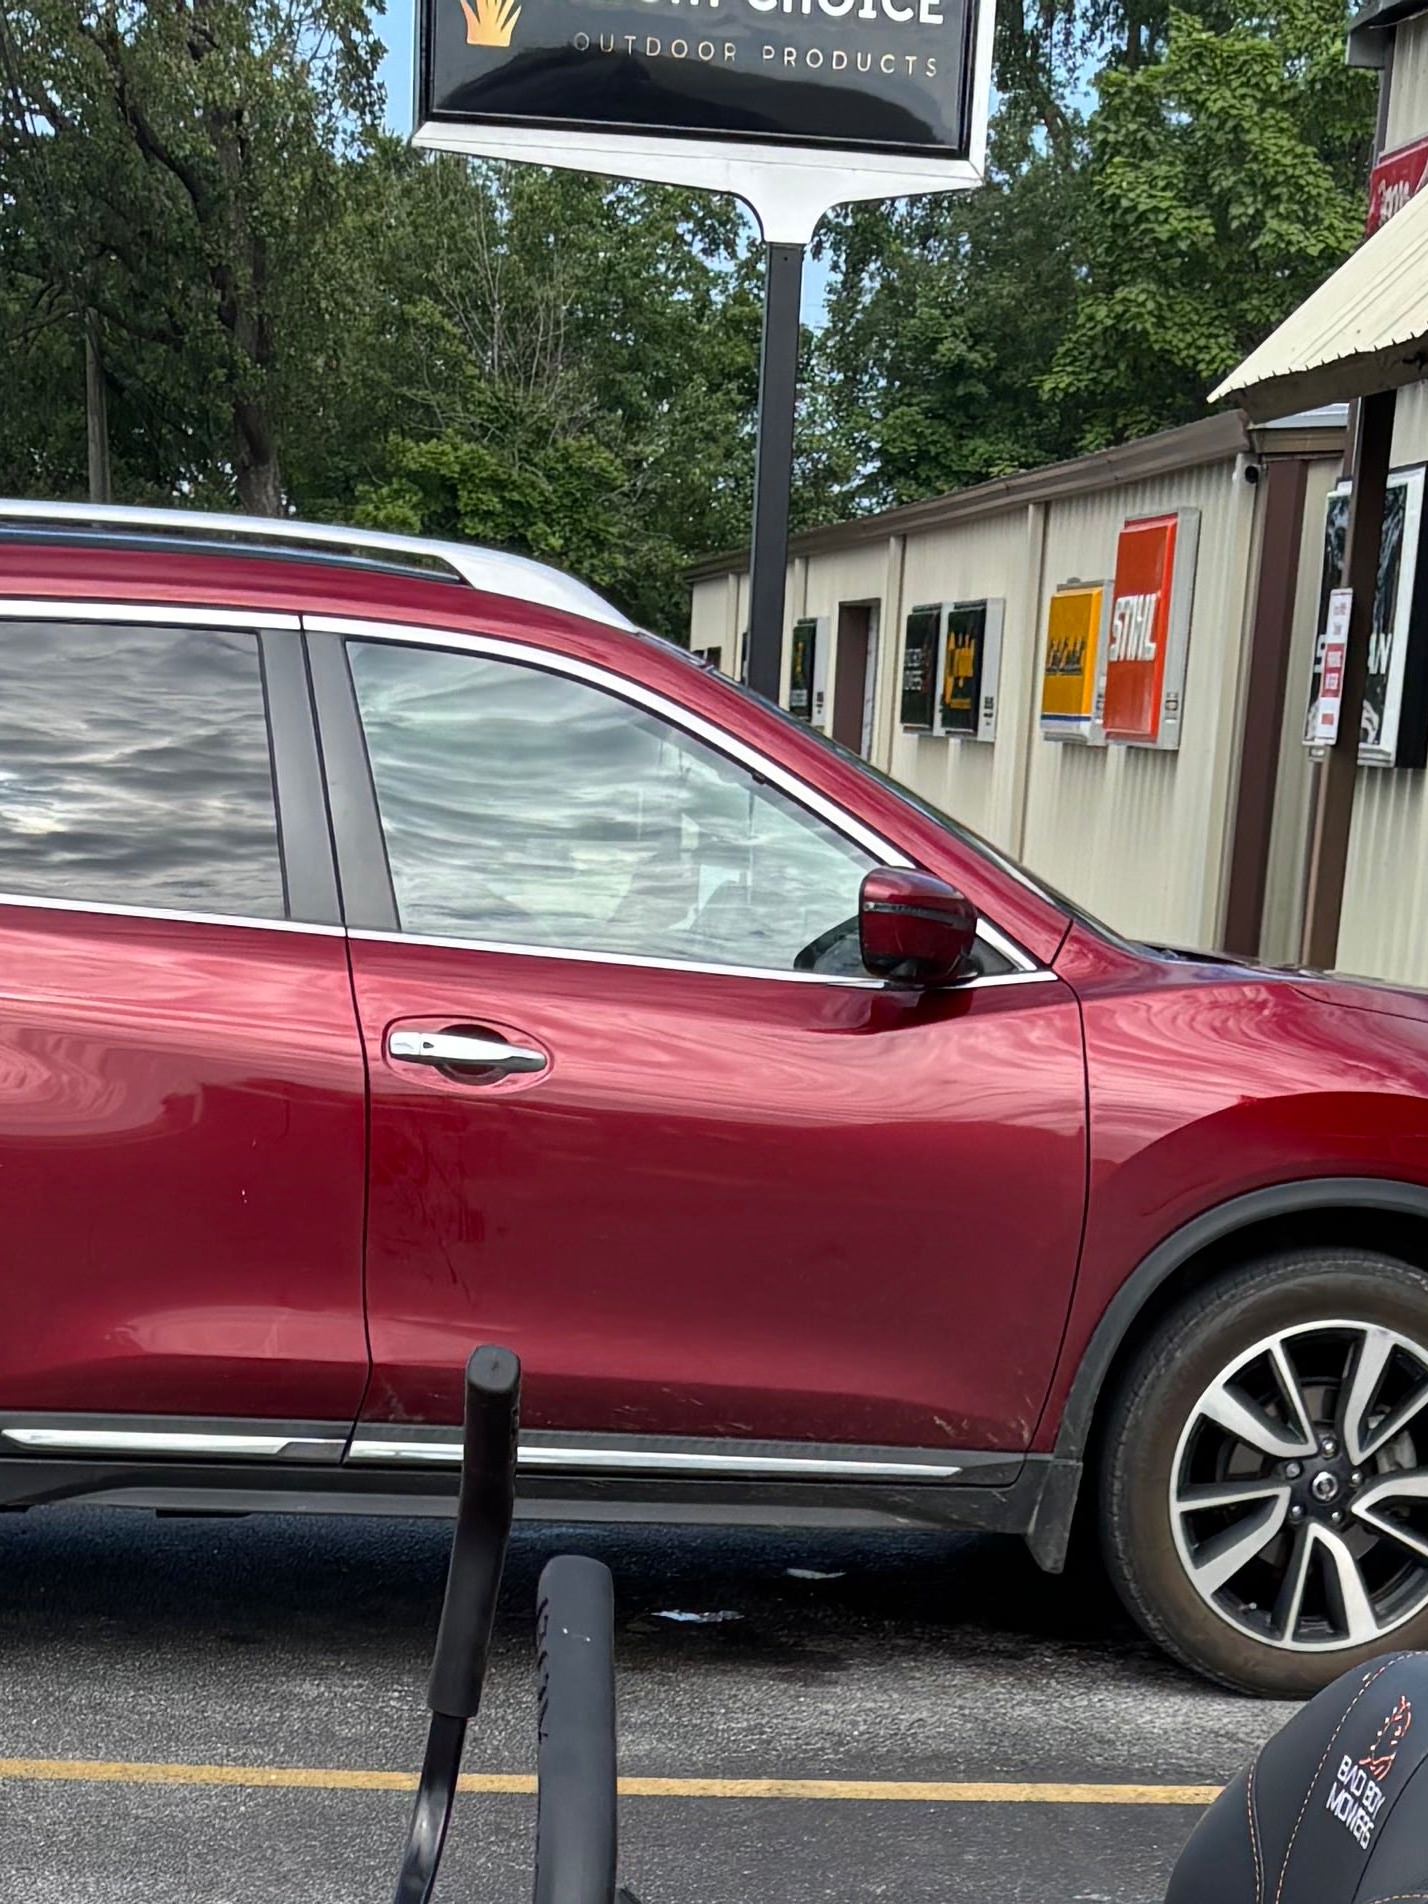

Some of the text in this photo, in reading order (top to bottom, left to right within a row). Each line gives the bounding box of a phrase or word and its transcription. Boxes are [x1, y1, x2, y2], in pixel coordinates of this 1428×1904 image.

[573, 32, 938, 78] OUTDOOR PRODUCTS
[1110, 593, 1158, 662] STIHL
[1337, 1754, 1386, 1821] BAD BOY
